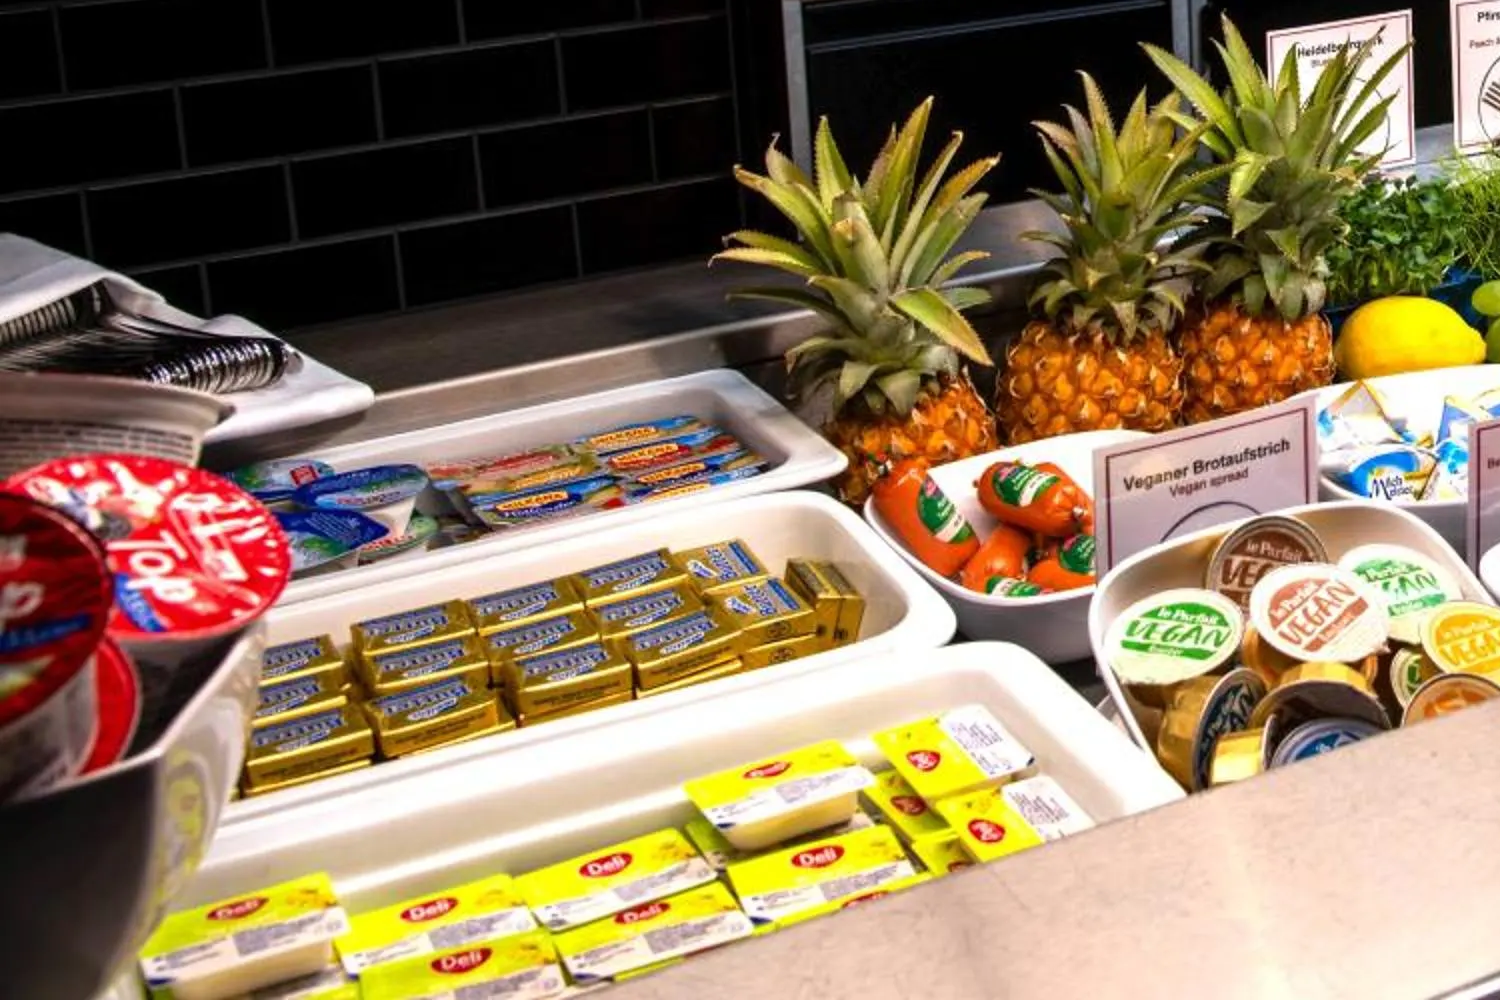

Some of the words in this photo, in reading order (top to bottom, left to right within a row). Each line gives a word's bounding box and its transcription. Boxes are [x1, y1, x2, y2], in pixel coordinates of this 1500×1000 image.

[1122, 465, 1189, 491] Veganer
[1192, 437, 1292, 476] Brotaufstrich
[1169, 479, 1207, 497] Vegan
[1209, 467, 1250, 487] spread
[1171, 607, 1220, 625] Parfait
[1278, 575, 1356, 647] VEGAN
[1124, 618, 1232, 649] VEGAN
[586, 855, 627, 875] Deli
[798, 846, 838, 867] Deli
[408, 898, 451, 921] Deli
[439, 952, 483, 972] Deli
